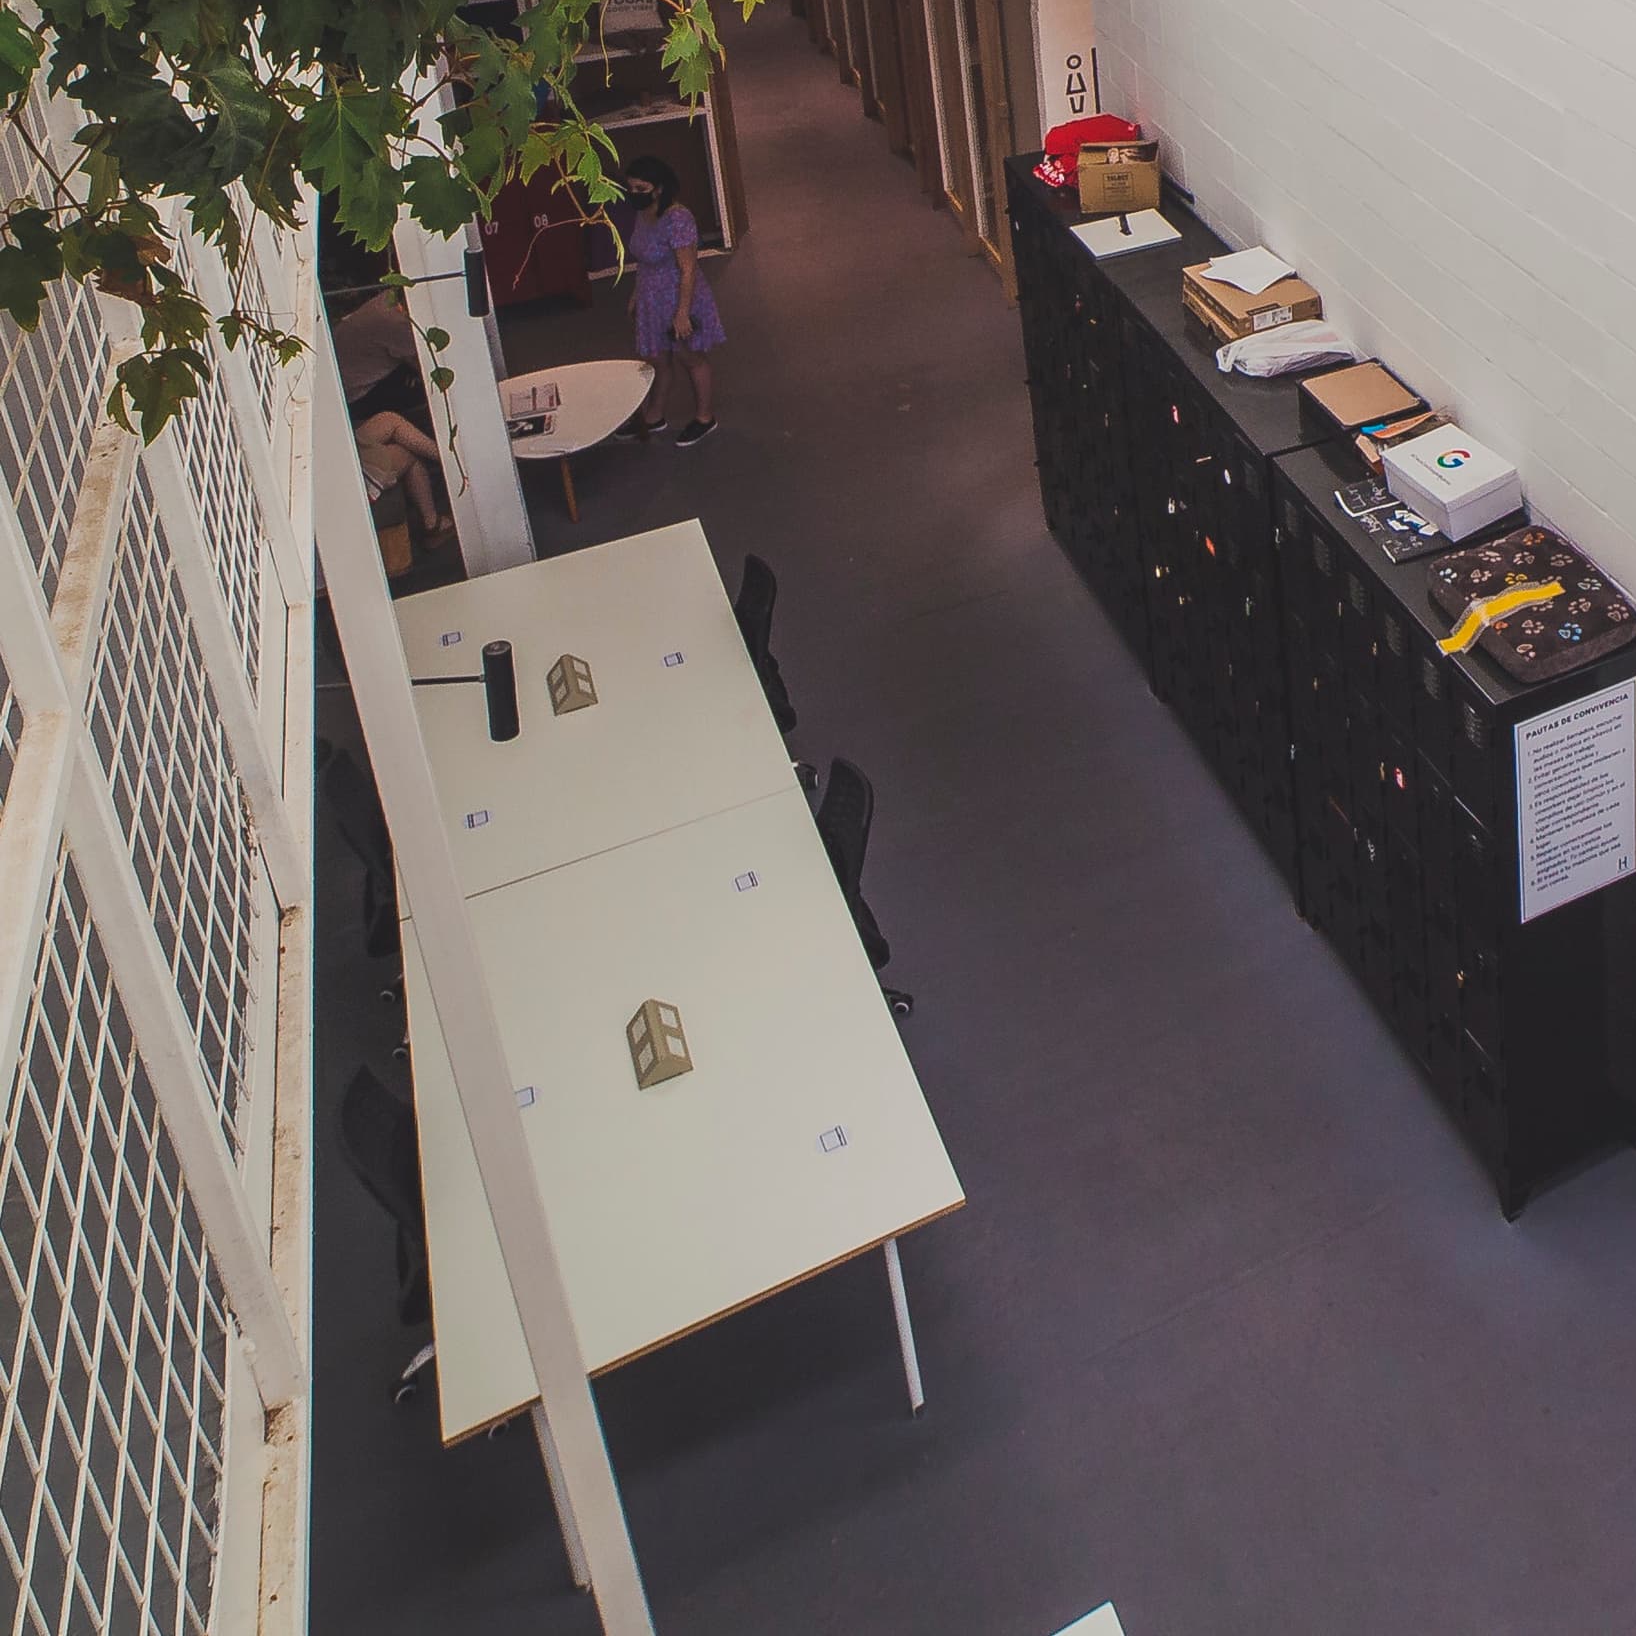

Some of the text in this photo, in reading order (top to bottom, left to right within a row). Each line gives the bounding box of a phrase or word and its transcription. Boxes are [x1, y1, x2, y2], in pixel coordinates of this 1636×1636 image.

[484, 221, 499, 236] 07
[1526, 693, 1628, 740] PAUTAS DE CONVIVENCIA
[1618, 856, 1627, 871] H
